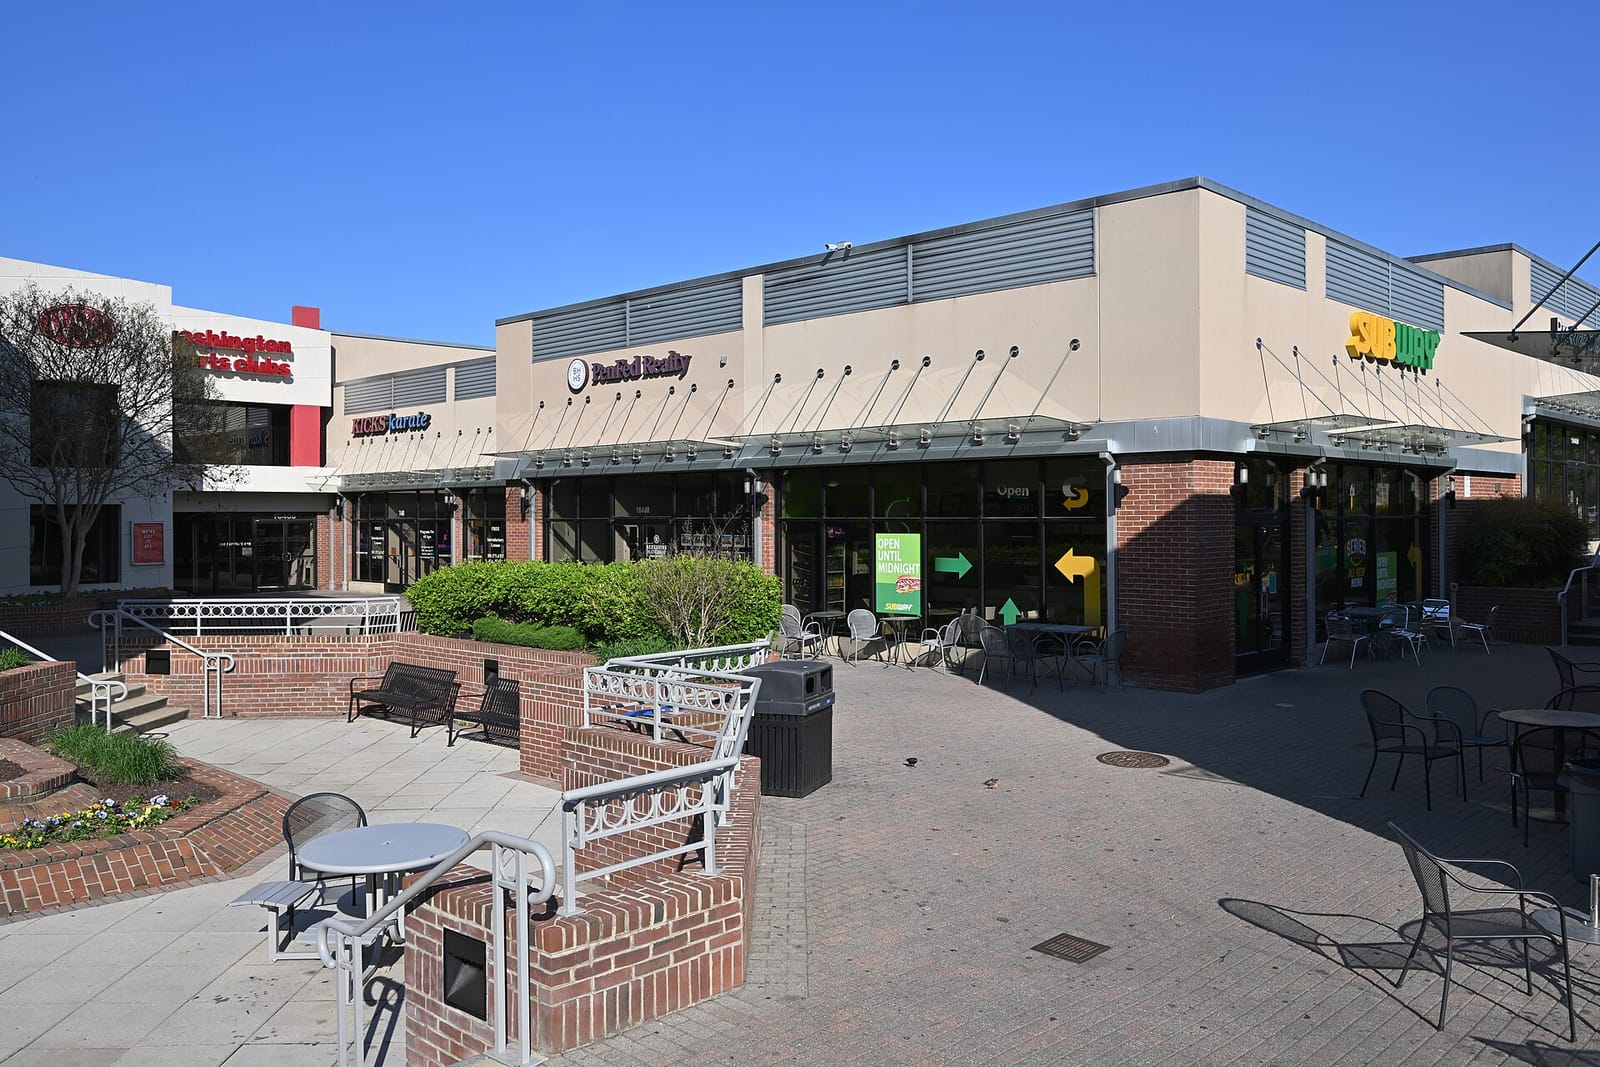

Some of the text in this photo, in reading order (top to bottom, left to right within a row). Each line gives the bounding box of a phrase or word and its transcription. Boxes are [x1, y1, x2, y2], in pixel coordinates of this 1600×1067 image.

[1345, 312, 1441, 369] SUBWAY
[233, 356, 291, 376] clubs
[591, 350, 692, 385] PenFed Realty
[352, 412, 429, 435] KICKS karate
[996, 484, 1030, 499] Open
[878, 538, 900, 549] OPEN
[878, 551, 902, 562] UNTIL
[878, 563, 921, 574] MIDNIGHT
[884, 603, 913, 611] SUBWAY
